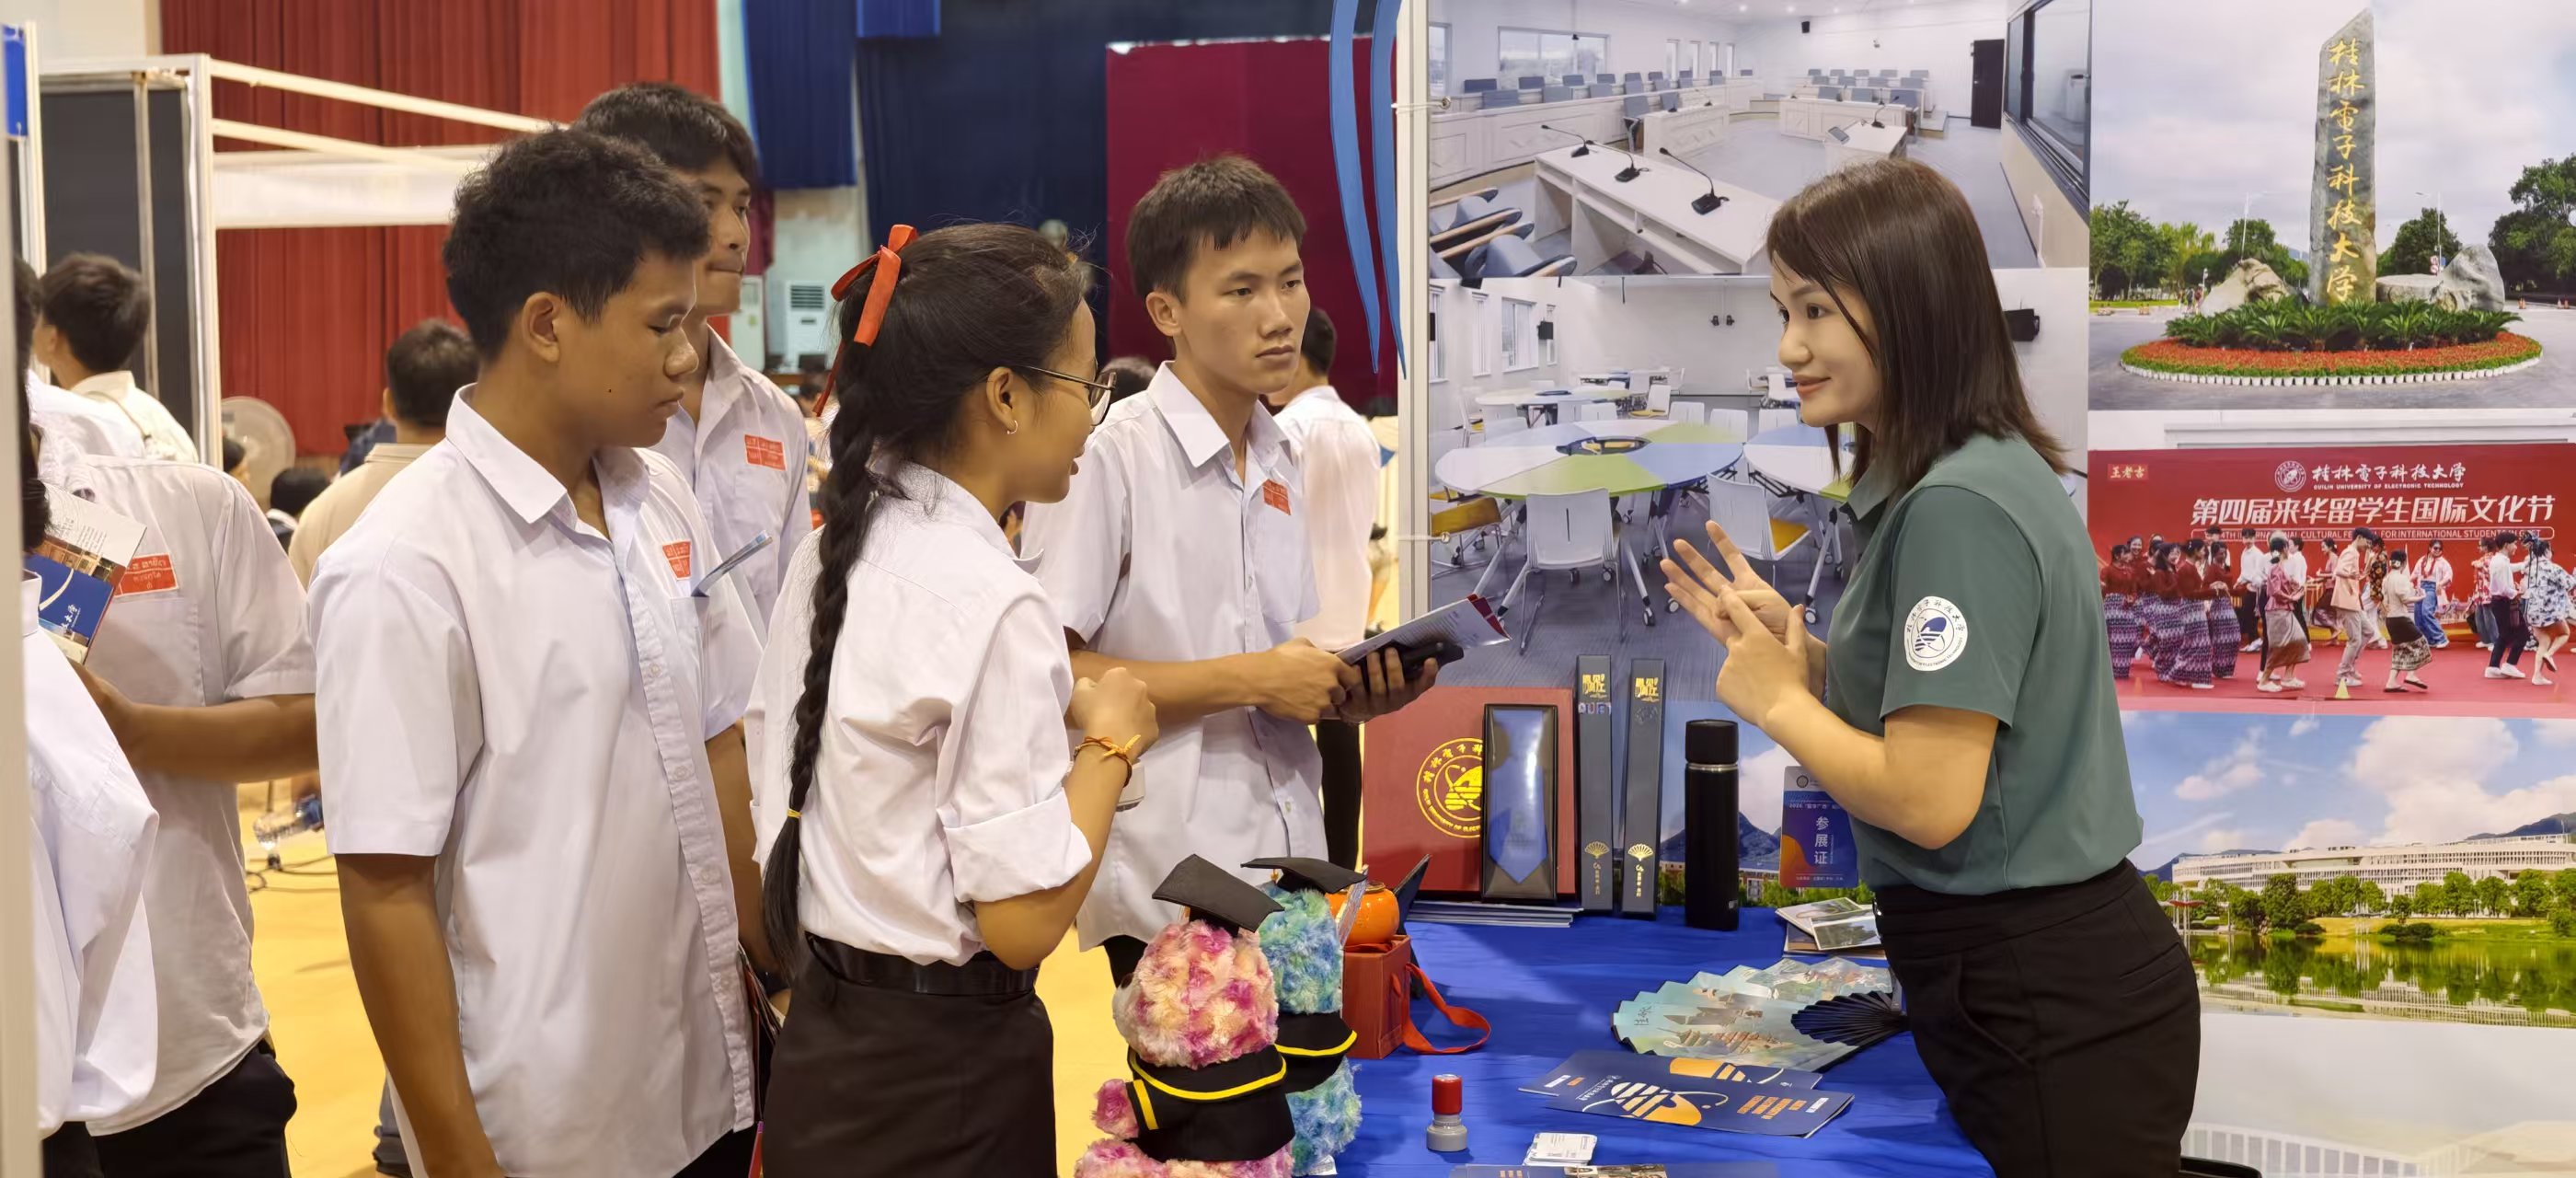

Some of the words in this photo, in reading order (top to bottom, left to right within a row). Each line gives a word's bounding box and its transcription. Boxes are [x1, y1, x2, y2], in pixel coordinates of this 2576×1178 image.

[2191, 494, 2556, 525] 第四届来华留学生国际文化节
[2300, 530, 2342, 538] CULTURAL
[2380, 530, 2397, 538] FOR
[2398, 529, 2461, 538] INTERNATIONAL
[1814, 815, 1830, 865] 参展证
